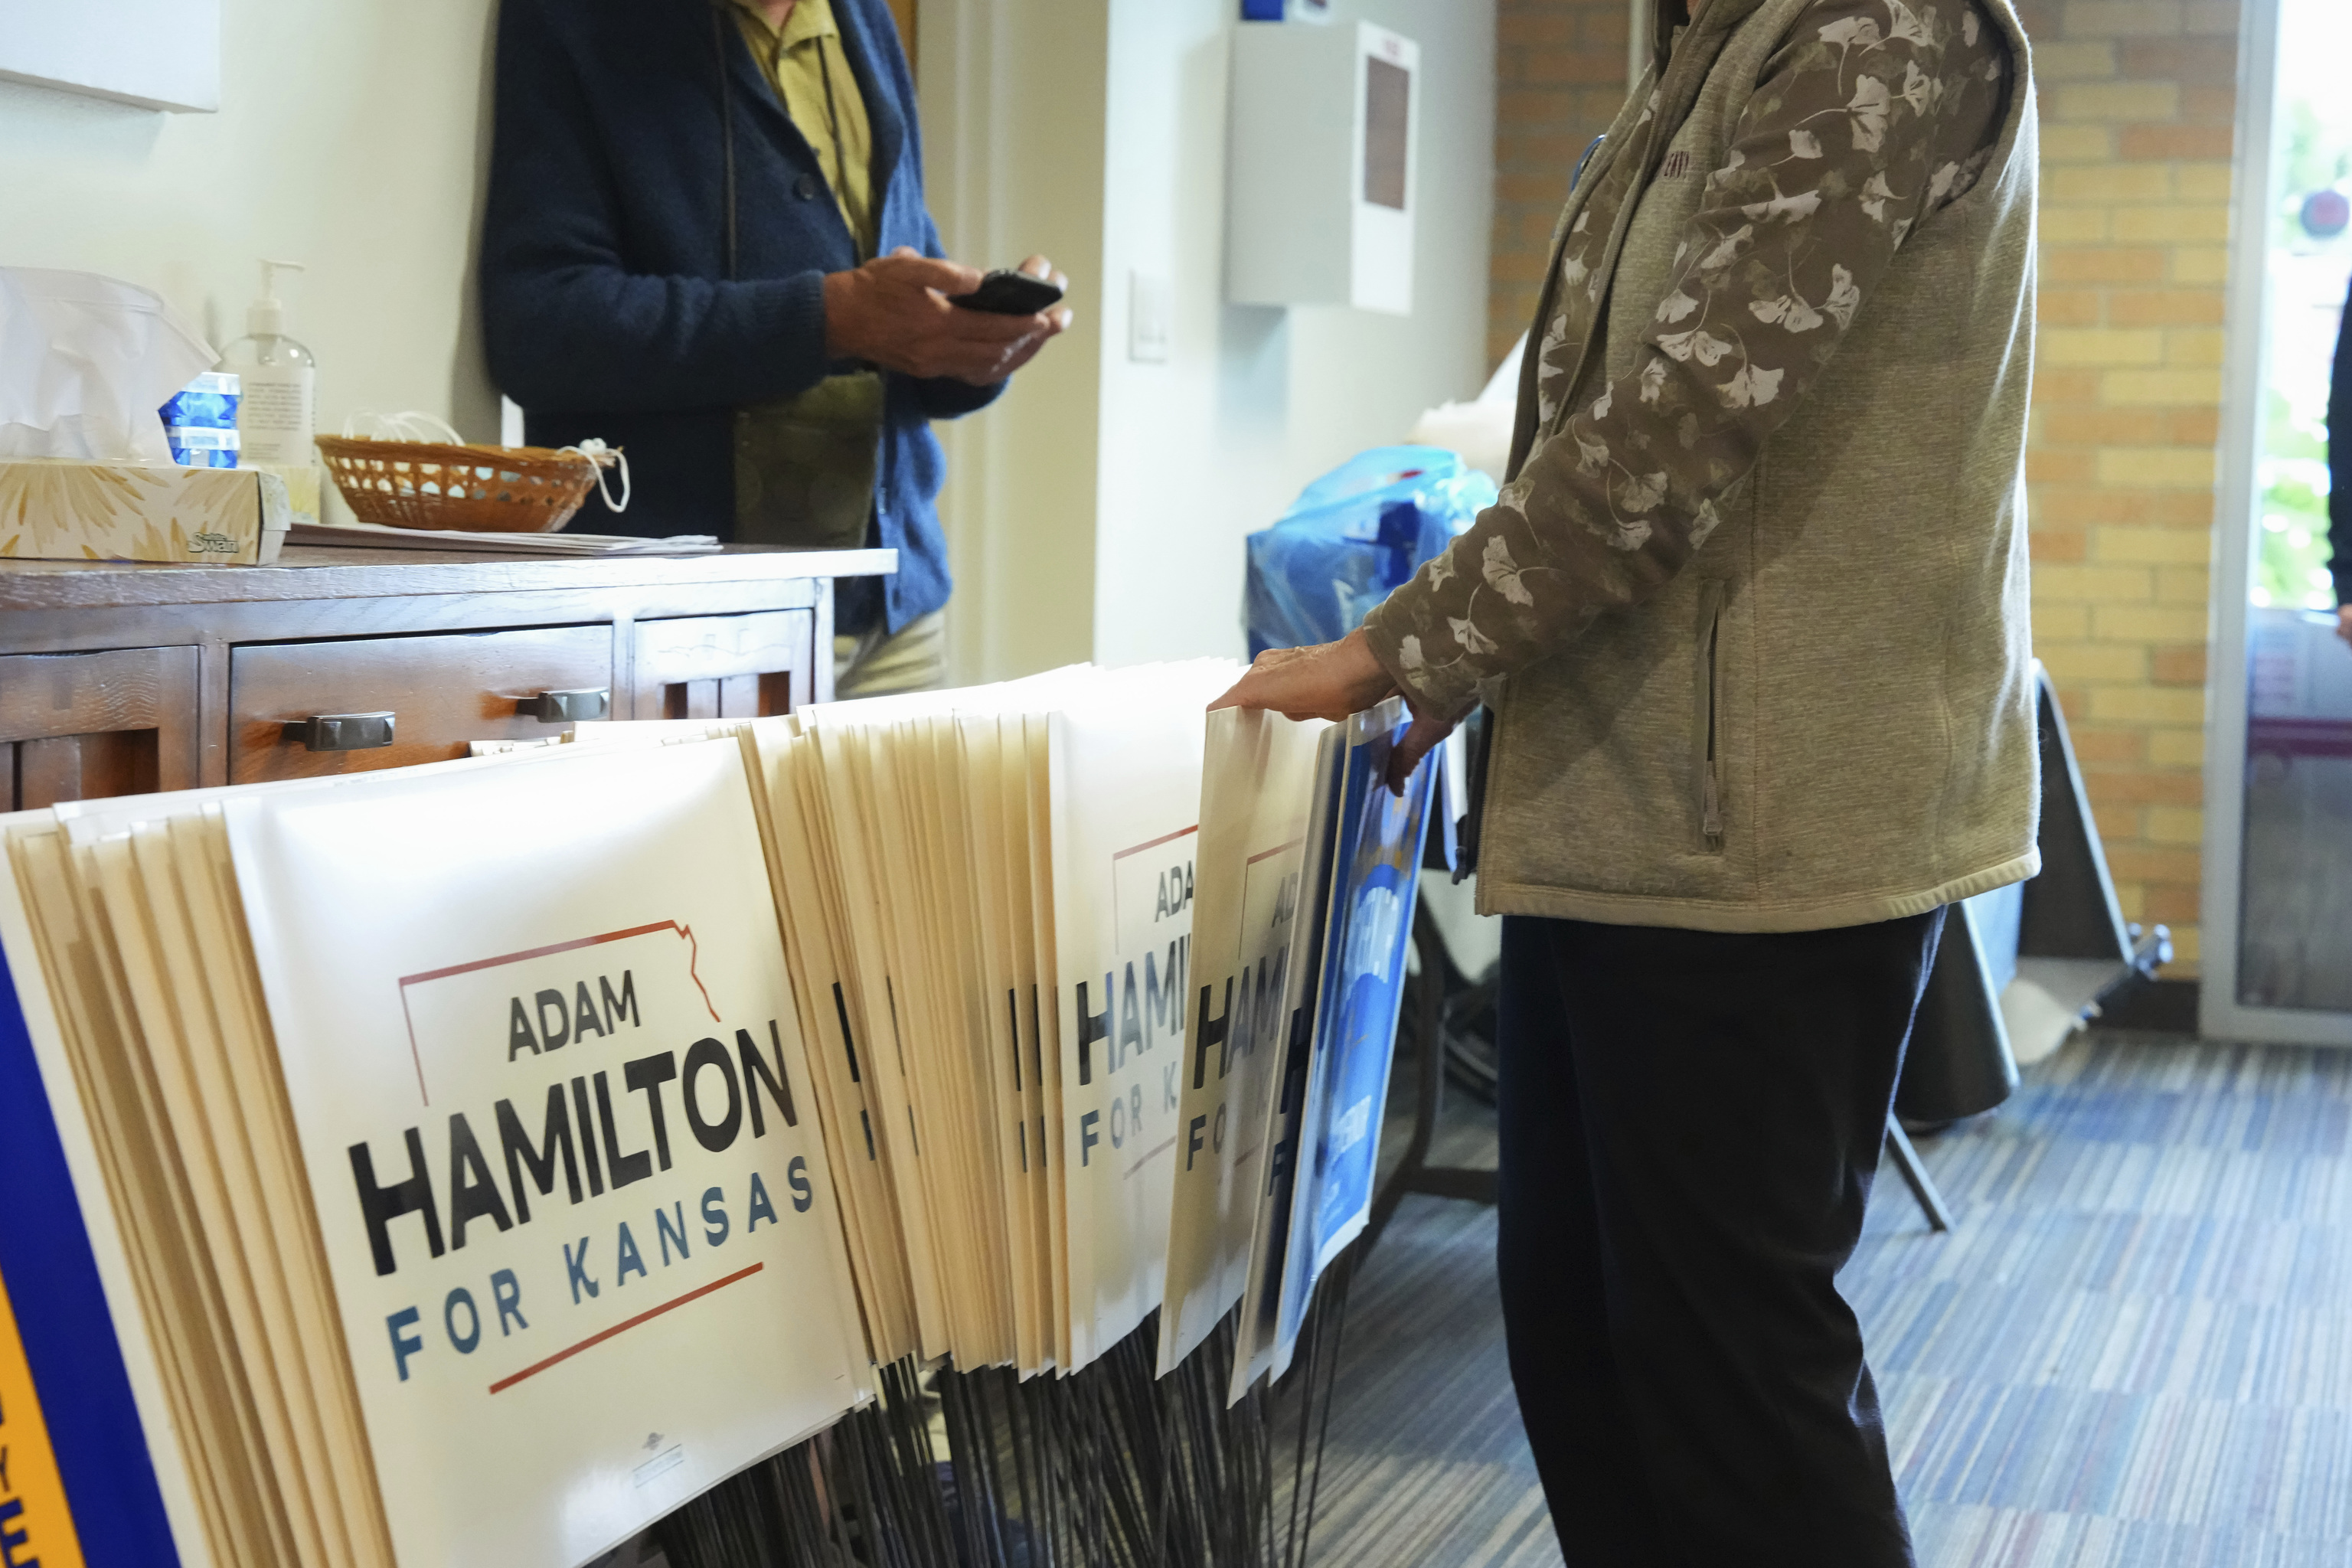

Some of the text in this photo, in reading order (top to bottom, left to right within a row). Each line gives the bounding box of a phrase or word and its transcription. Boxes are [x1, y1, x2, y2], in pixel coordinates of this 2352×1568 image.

[508, 969, 641, 1063] ADAM
[348, 1019, 799, 1277] HAMILTON
[385, 1155, 813, 1382] FOR KANSAS
